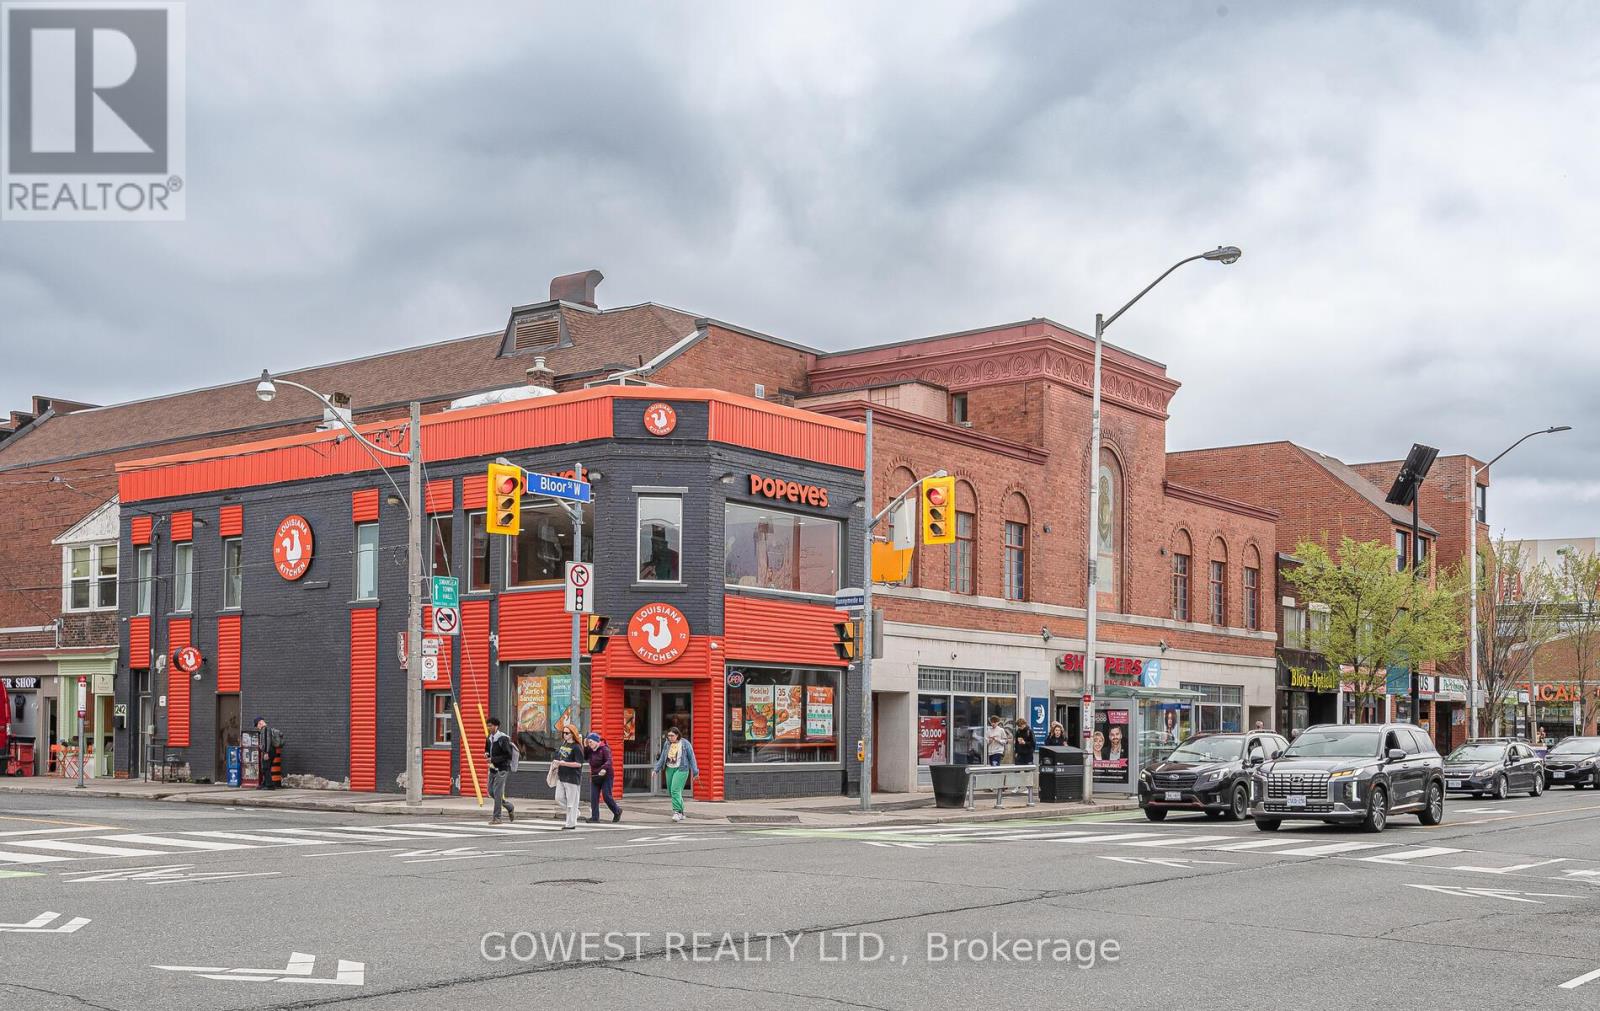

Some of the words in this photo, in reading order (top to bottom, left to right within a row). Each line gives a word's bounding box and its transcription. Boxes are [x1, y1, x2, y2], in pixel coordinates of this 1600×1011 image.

[540, 477, 567, 493] Bloor
[574, 484, 580, 496] W
[279, 519, 308, 538] LOUISIANA
[279, 561, 306, 577] KITCHEN
[636, 606, 681, 624] LOUISIANA
[638, 646, 678, 661] KITCHEN
[1063, 652, 1142, 676] SHPERS
[15, 677, 37, 688] SHOP
[921, 728, 942, 738] 30,000
